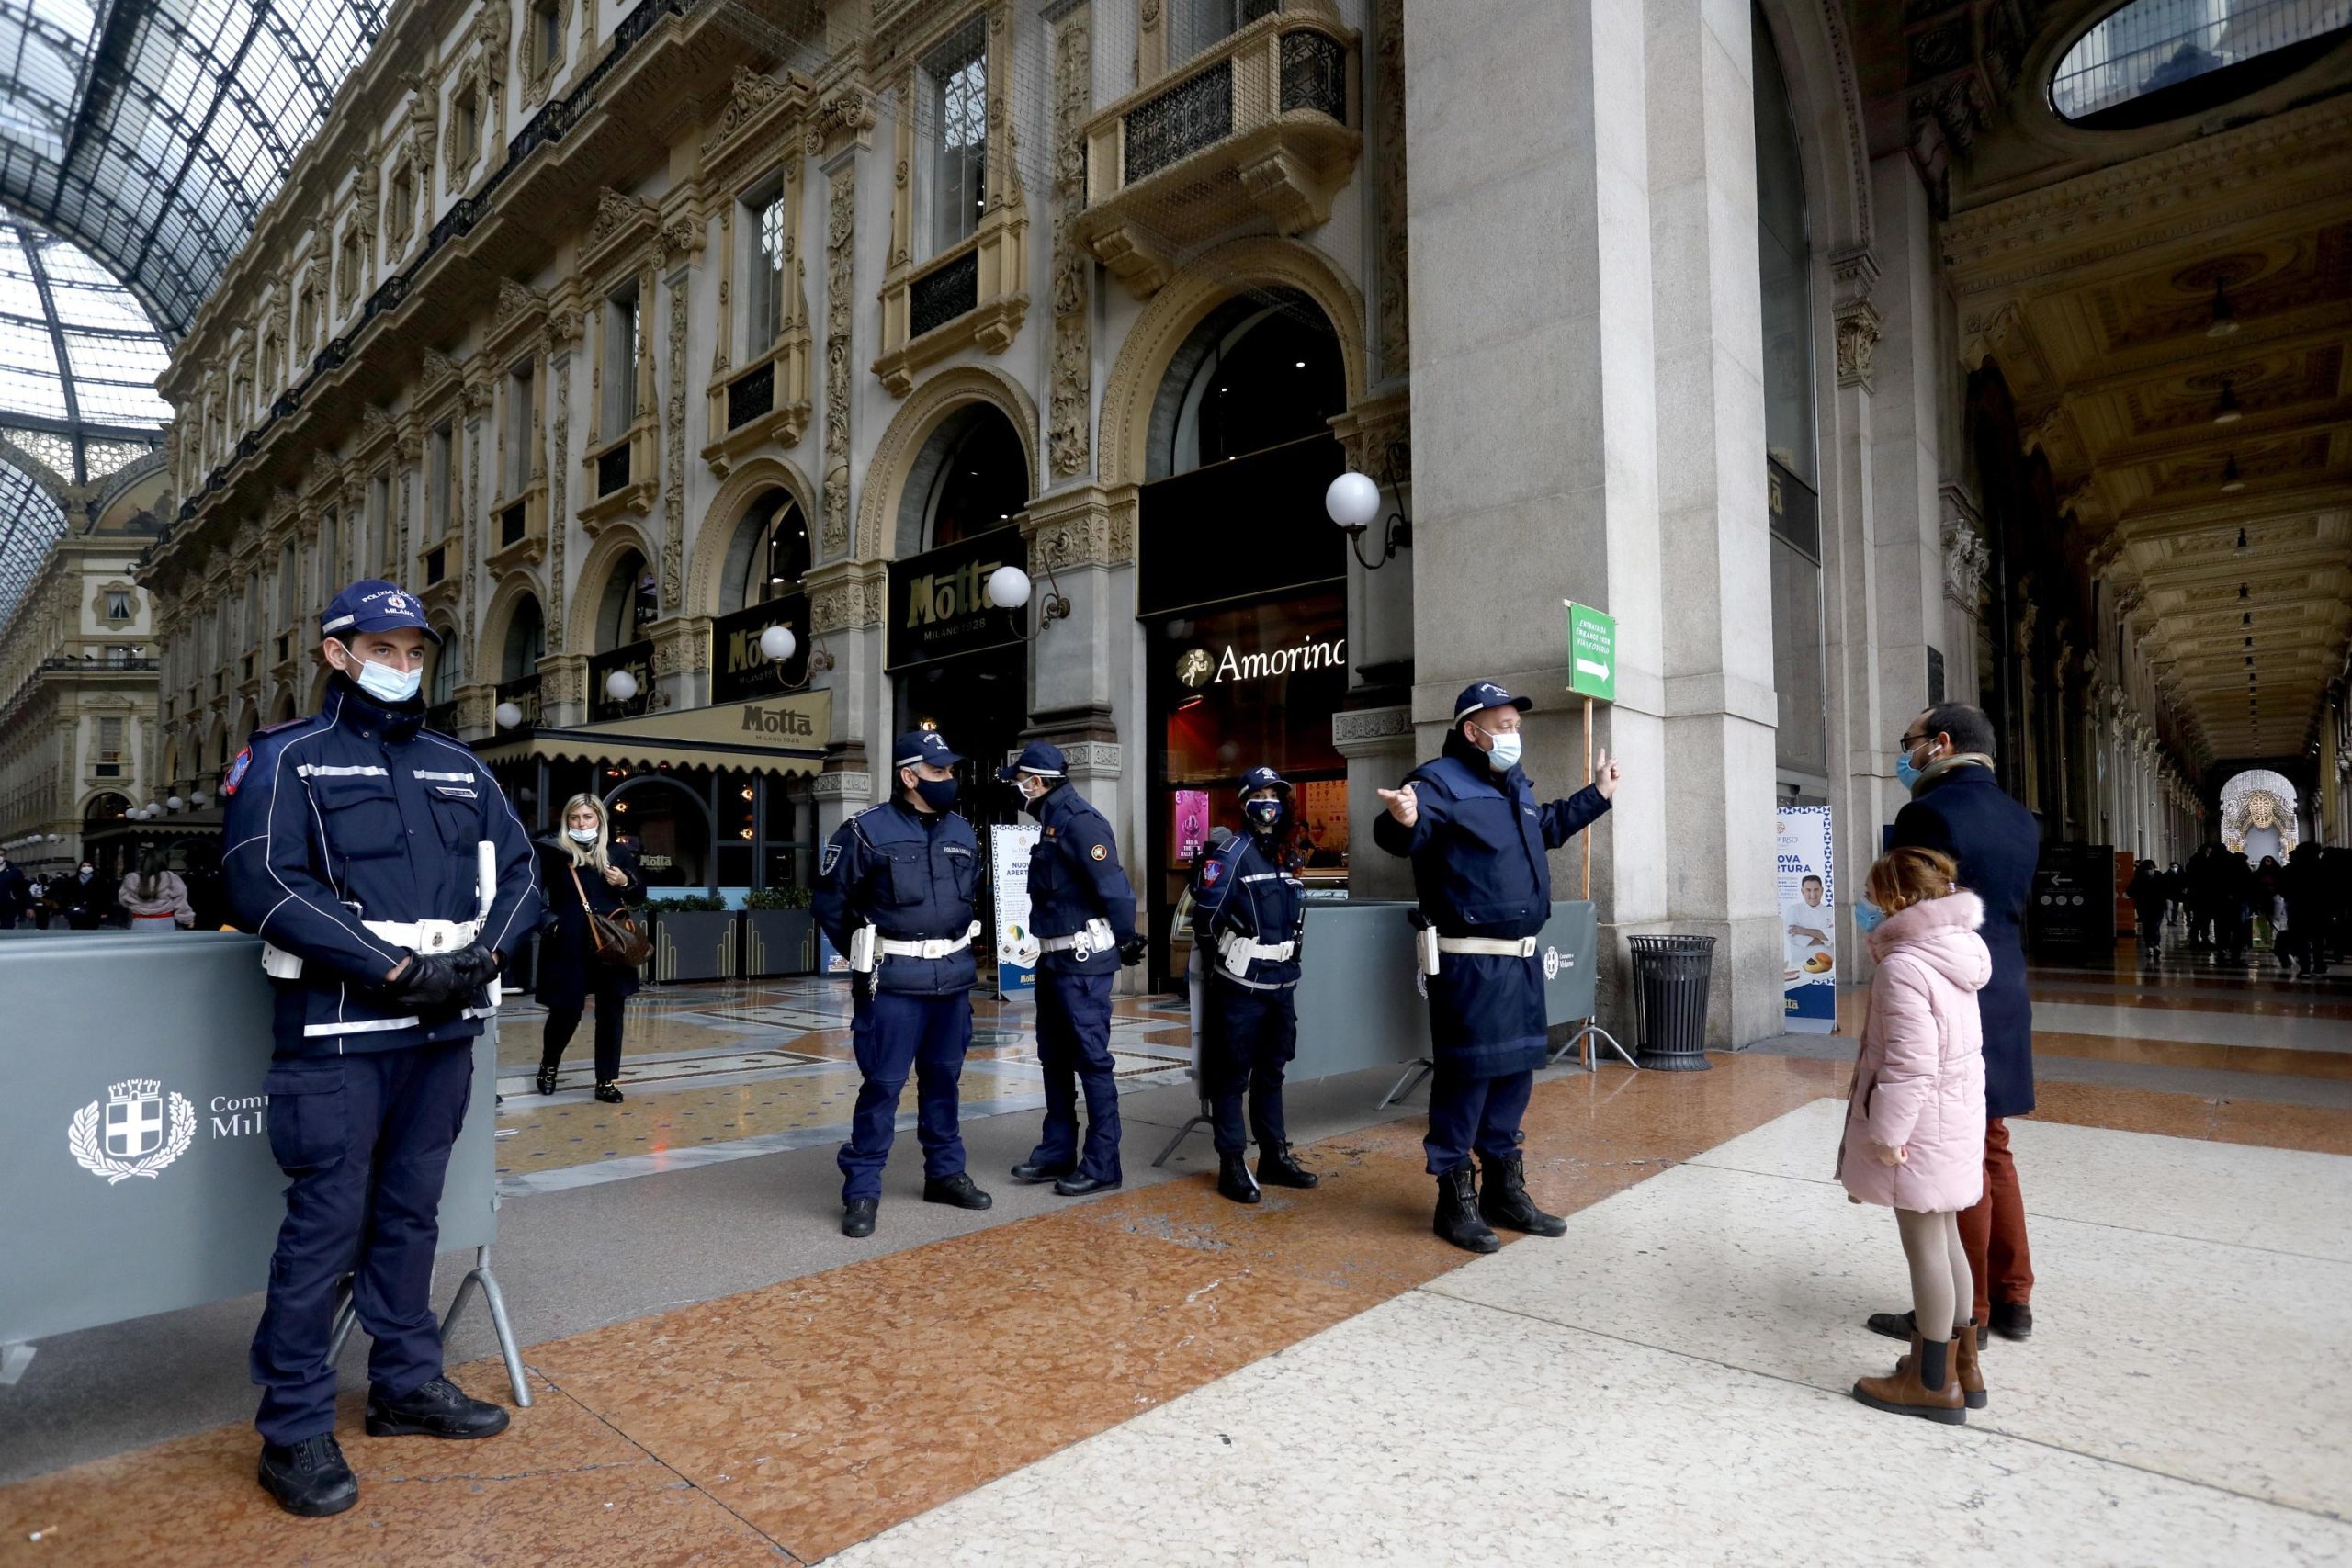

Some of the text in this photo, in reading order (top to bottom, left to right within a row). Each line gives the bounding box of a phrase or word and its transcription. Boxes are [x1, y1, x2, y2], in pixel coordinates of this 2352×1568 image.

[362, 590, 394, 603] POLIZIA
[385, 608, 414, 617] MILANO
[924, 617, 986, 641] MILANO 1928
[728, 619, 793, 673] Mot
[741, 705, 813, 736] Motta
[639, 854, 672, 867] Motta
[209, 1111, 267, 1139] Mil
